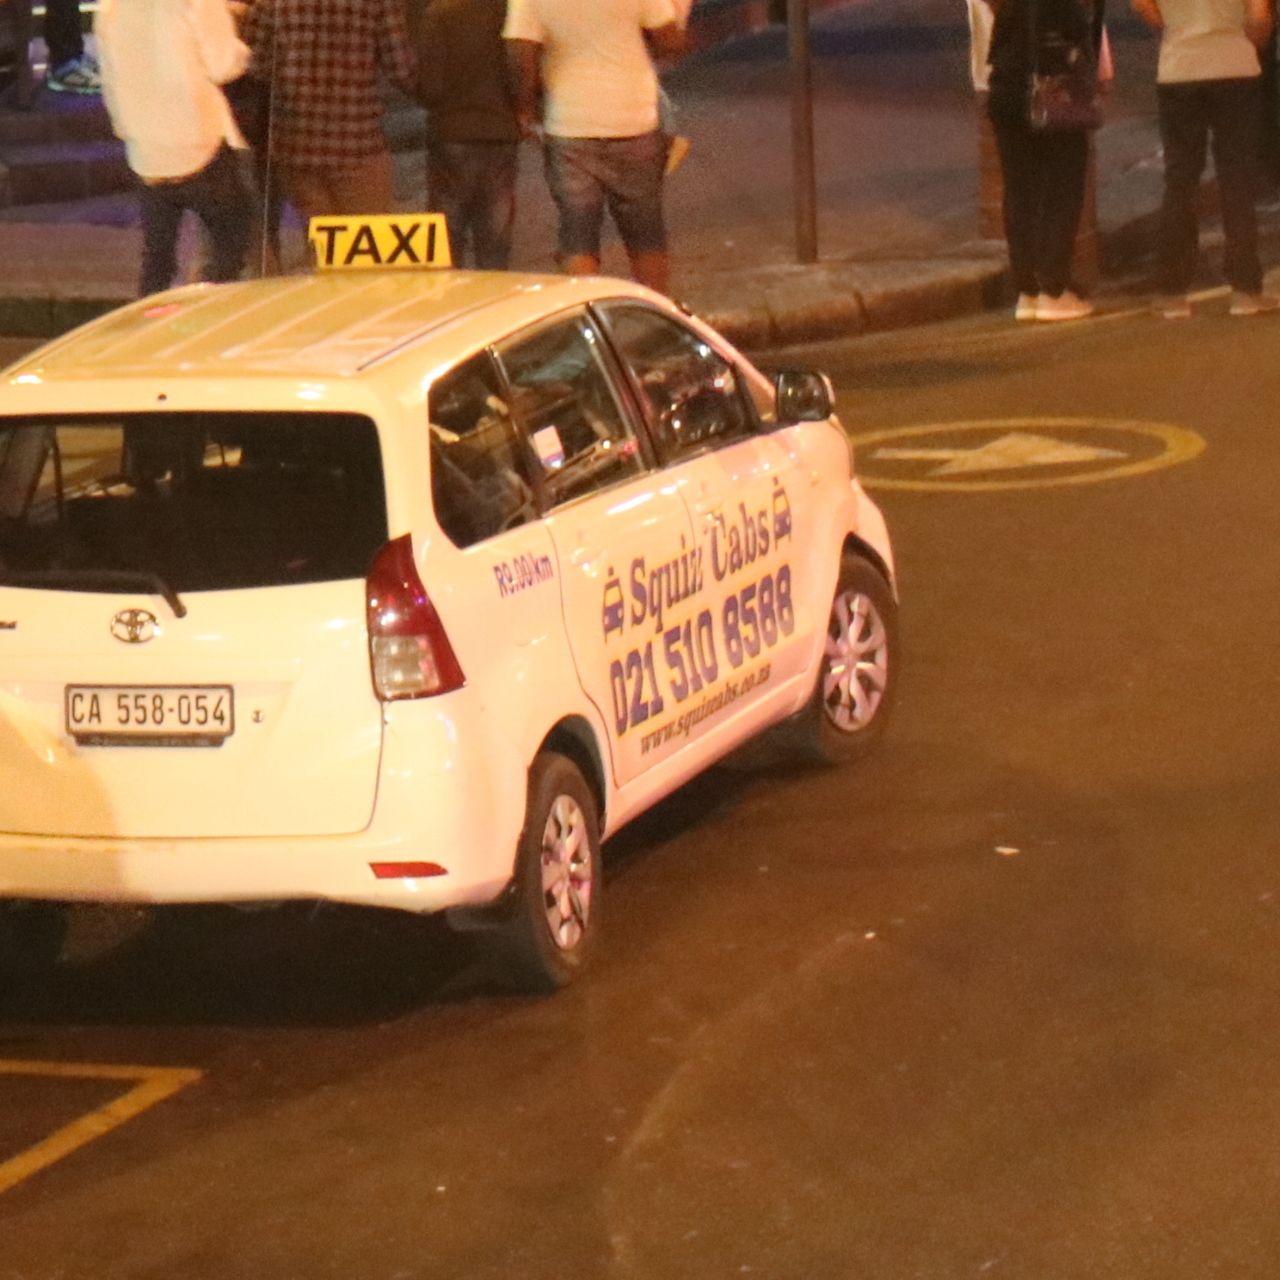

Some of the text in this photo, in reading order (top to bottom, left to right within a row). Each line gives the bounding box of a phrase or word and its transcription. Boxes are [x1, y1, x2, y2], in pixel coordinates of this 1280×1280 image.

[316, 222, 438, 267] TAXI
[628, 502, 771, 634] Squiz Cabs
[609, 563, 795, 737] 021 510 8588
[71, 691, 227, 726] CA 558-054
